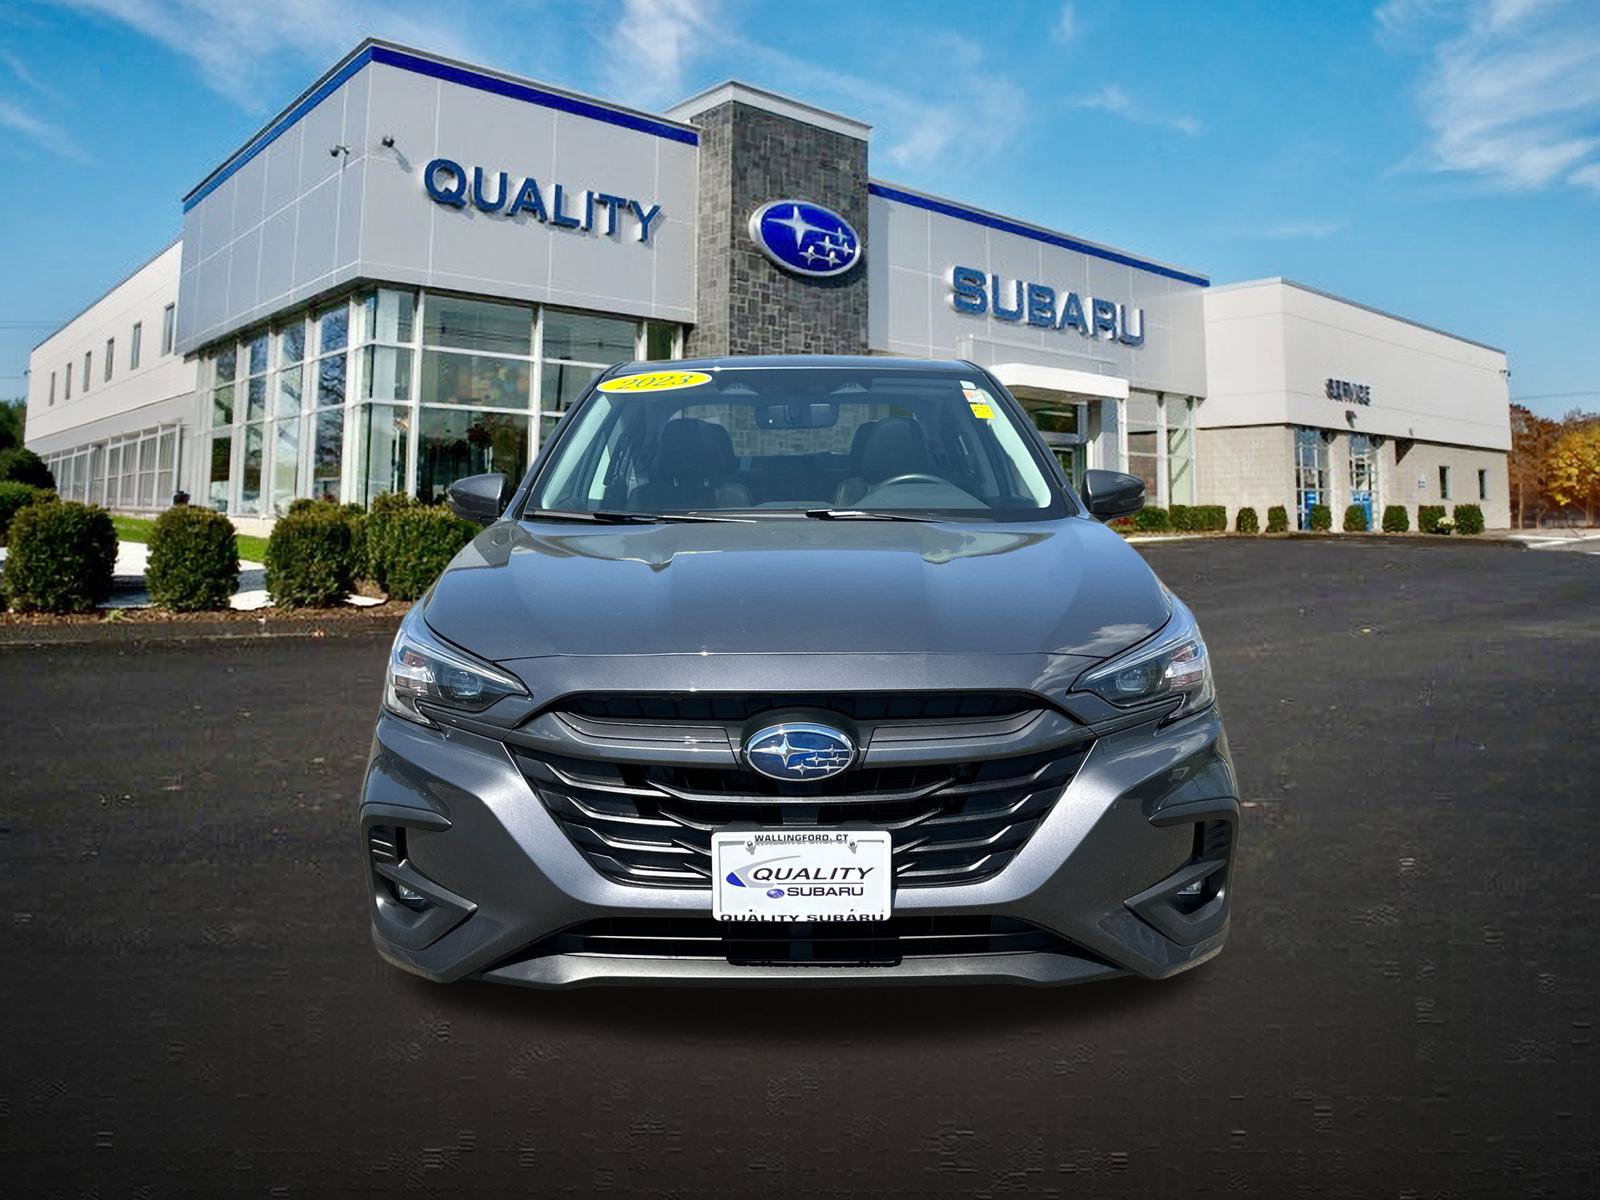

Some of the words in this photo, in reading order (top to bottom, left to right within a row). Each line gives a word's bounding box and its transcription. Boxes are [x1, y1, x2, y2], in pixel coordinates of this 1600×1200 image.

[424, 158, 662, 243] QUALITY
[951, 265, 1145, 347] SUBARU
[617, 375, 693, 389] 2023
[753, 867, 874, 880] QUALITY
[787, 887, 863, 896] SUBARU
